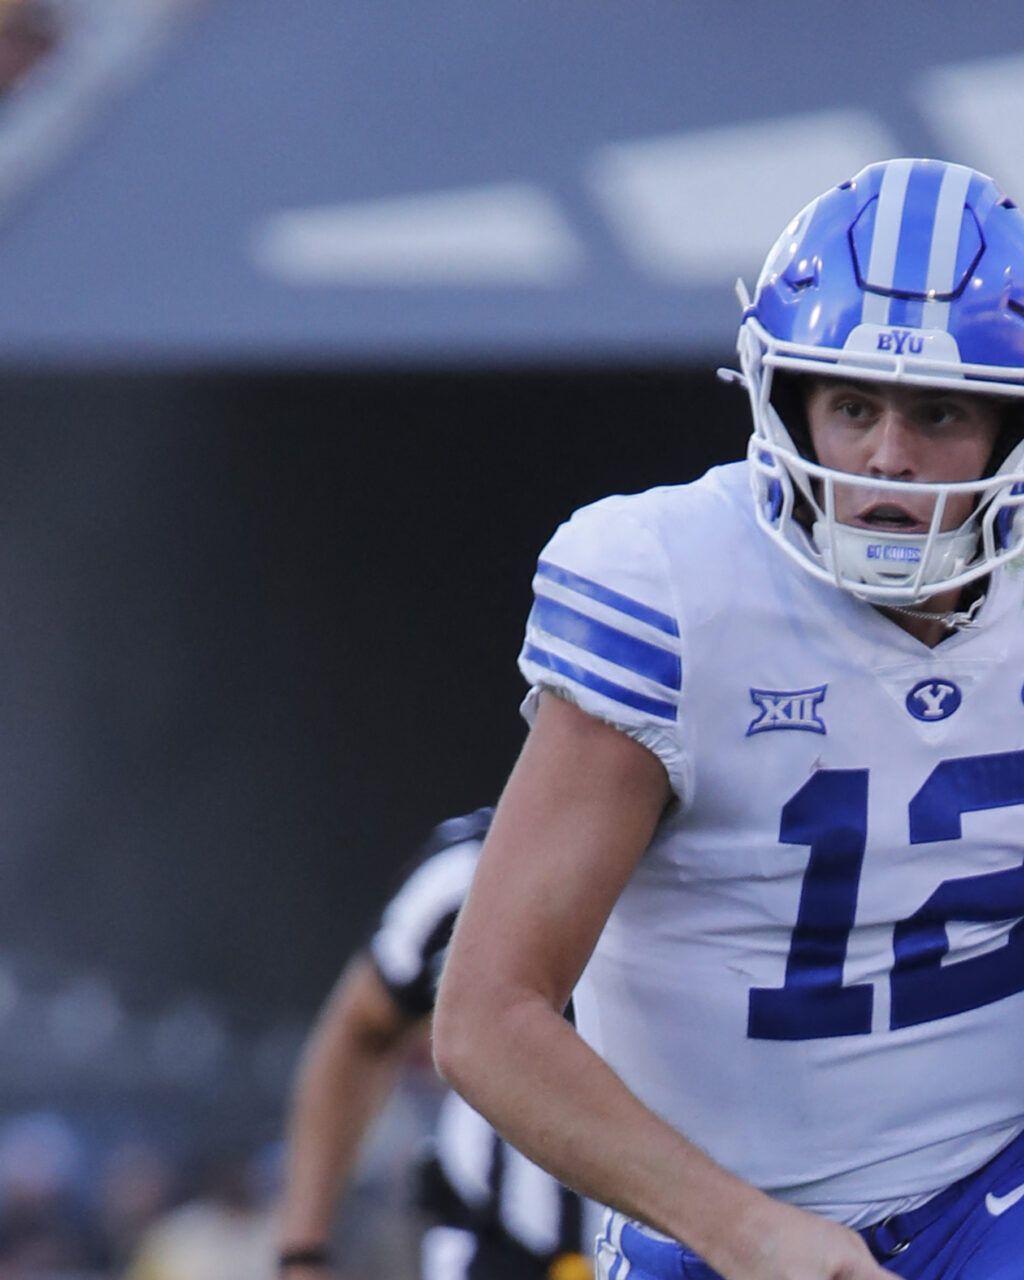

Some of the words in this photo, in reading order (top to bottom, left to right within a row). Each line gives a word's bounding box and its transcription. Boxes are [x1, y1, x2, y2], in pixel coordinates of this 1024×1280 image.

[877, 329, 924, 355] BYU
[748, 686, 826, 735] XII
[913, 685, 954, 717] Y
